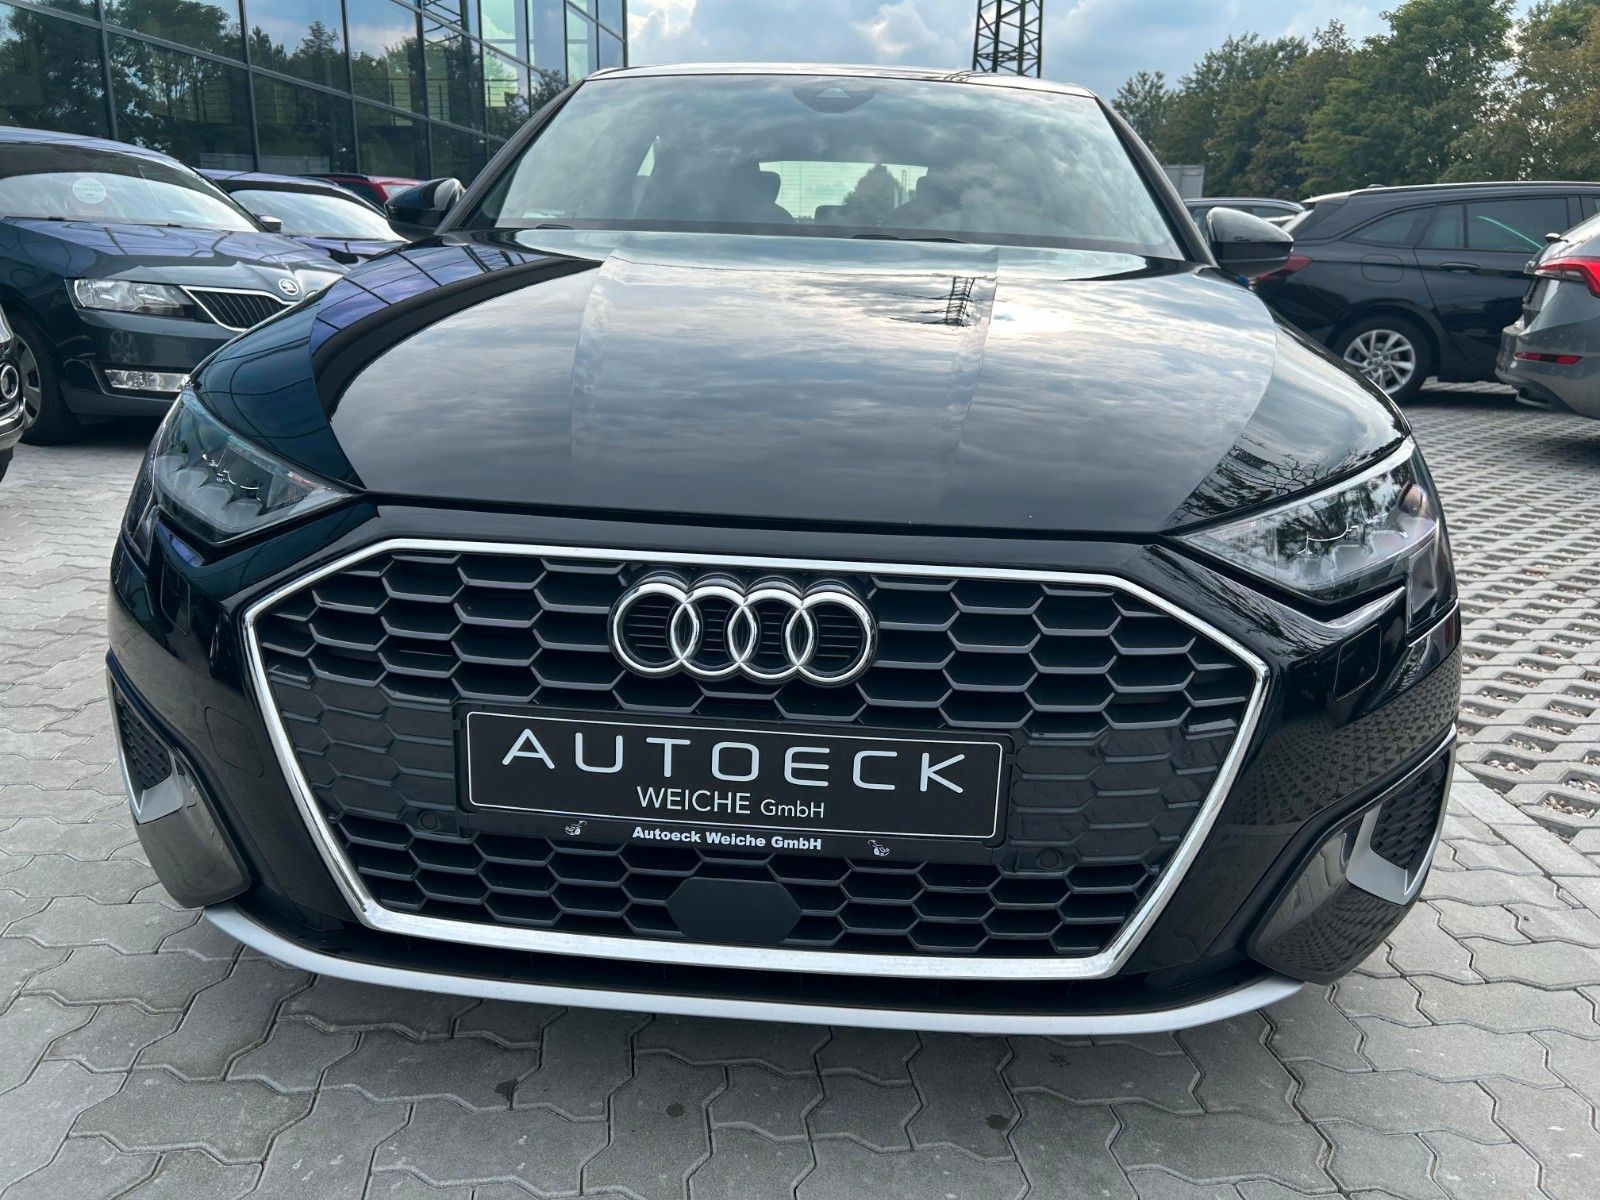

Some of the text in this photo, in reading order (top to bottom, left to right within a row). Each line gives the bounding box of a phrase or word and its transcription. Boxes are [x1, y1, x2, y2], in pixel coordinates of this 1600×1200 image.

[501, 728, 966, 794] AUTOECK
[636, 785, 825, 819] WEICHE GmbH
[632, 826, 822, 851] Autoeck Weiche GmbH
